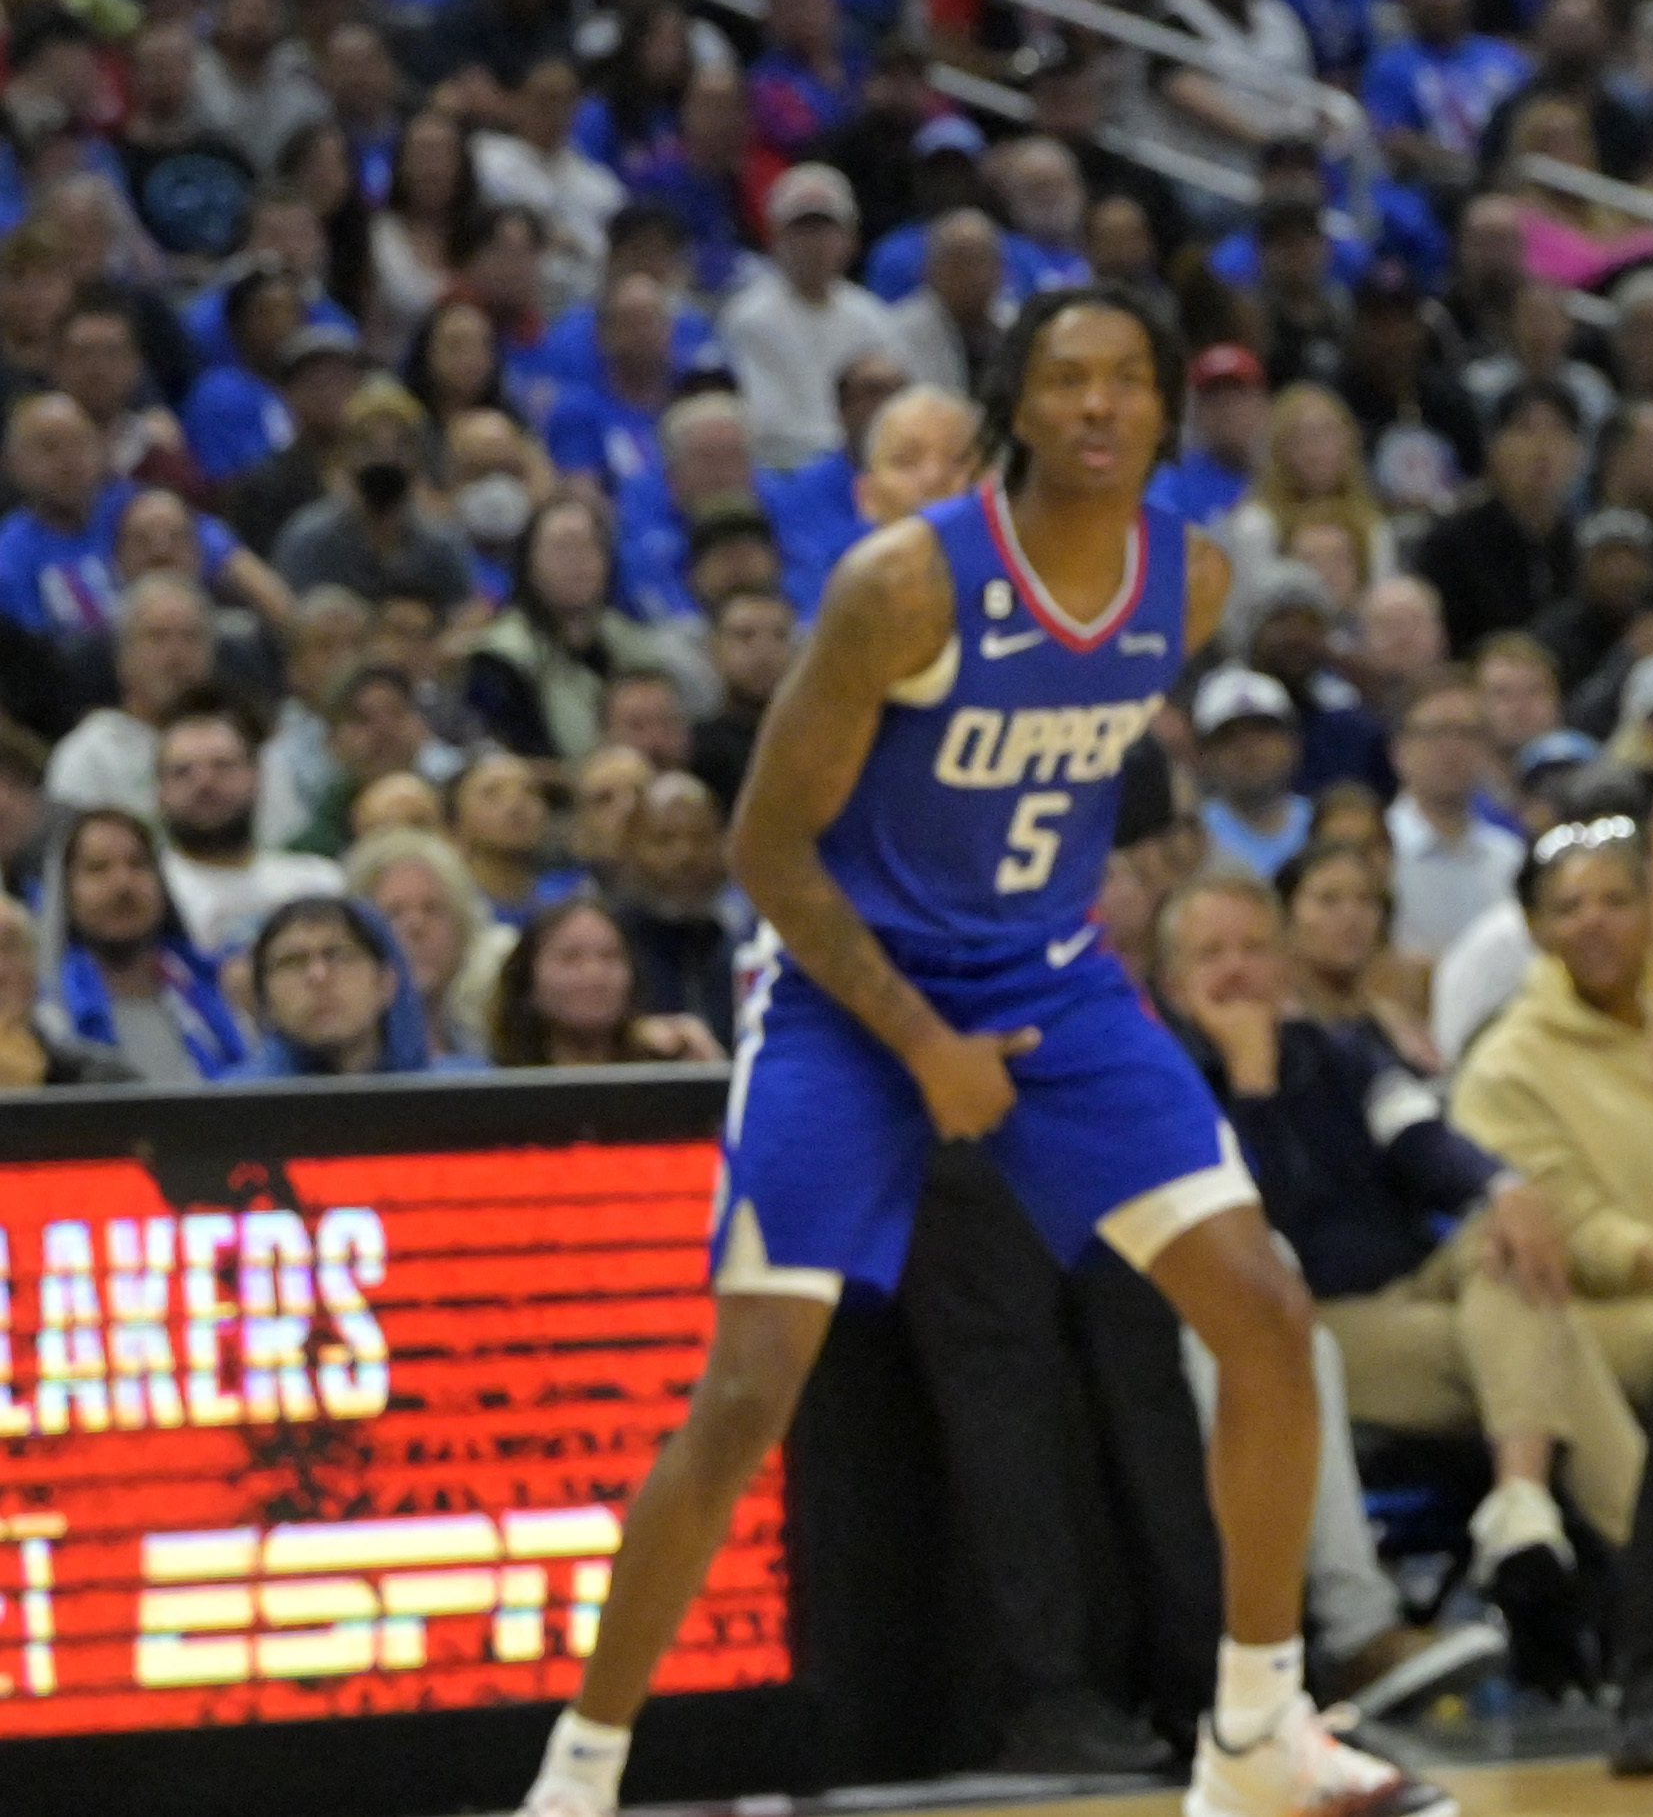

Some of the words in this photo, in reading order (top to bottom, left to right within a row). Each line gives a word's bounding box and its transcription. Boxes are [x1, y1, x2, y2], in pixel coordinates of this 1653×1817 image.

[933, 691, 1166, 790] CLIPPER
[994, 790, 1073, 896] 5
[0, 1205, 390, 1438] LAKERS
[134, 1504, 624, 1689] ESPN
